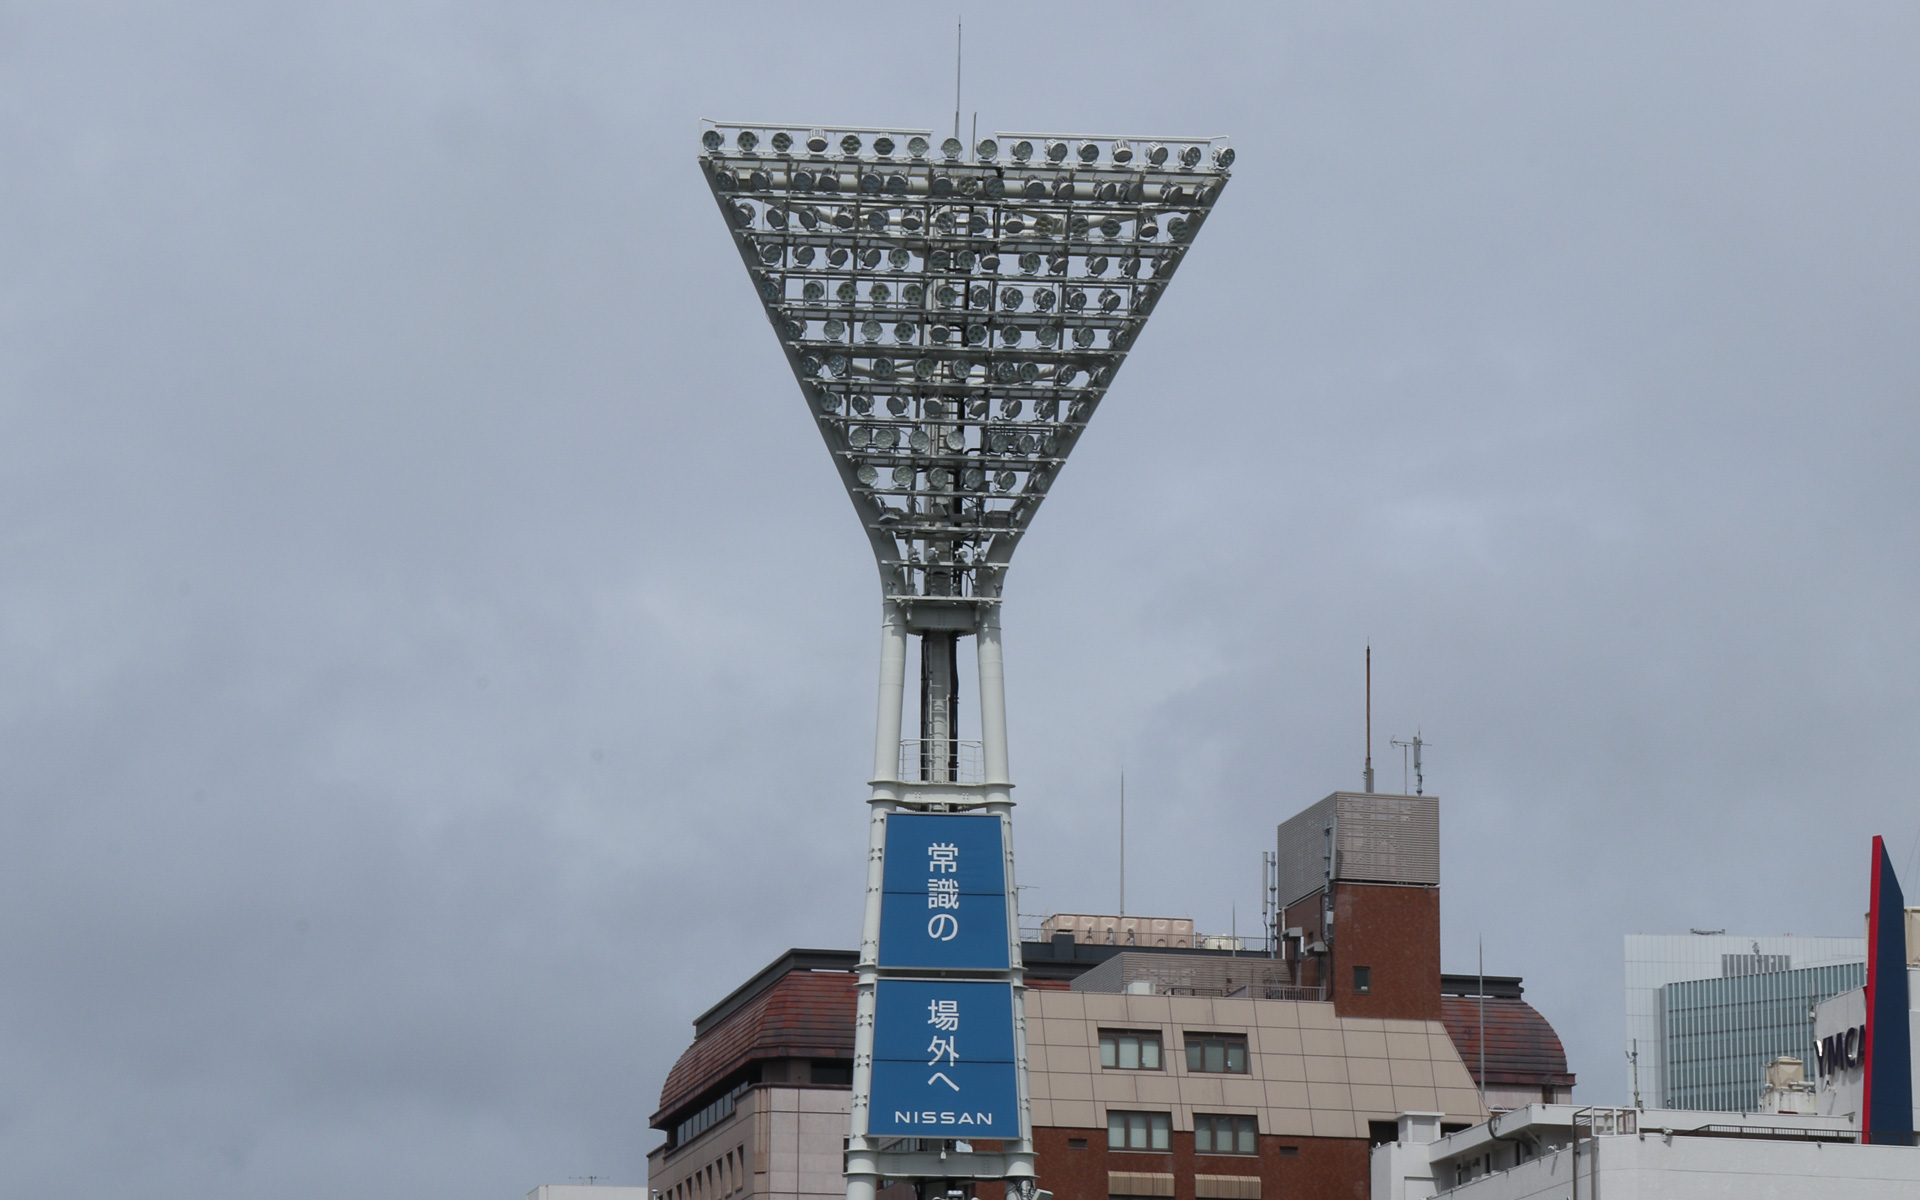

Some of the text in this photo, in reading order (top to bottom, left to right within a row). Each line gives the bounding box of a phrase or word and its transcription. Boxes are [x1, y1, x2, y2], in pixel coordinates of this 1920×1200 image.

[927, 842, 959, 942] 常識の
[927, 999, 960, 1092] 場外へ
[895, 1111, 993, 1125] NISSAN
